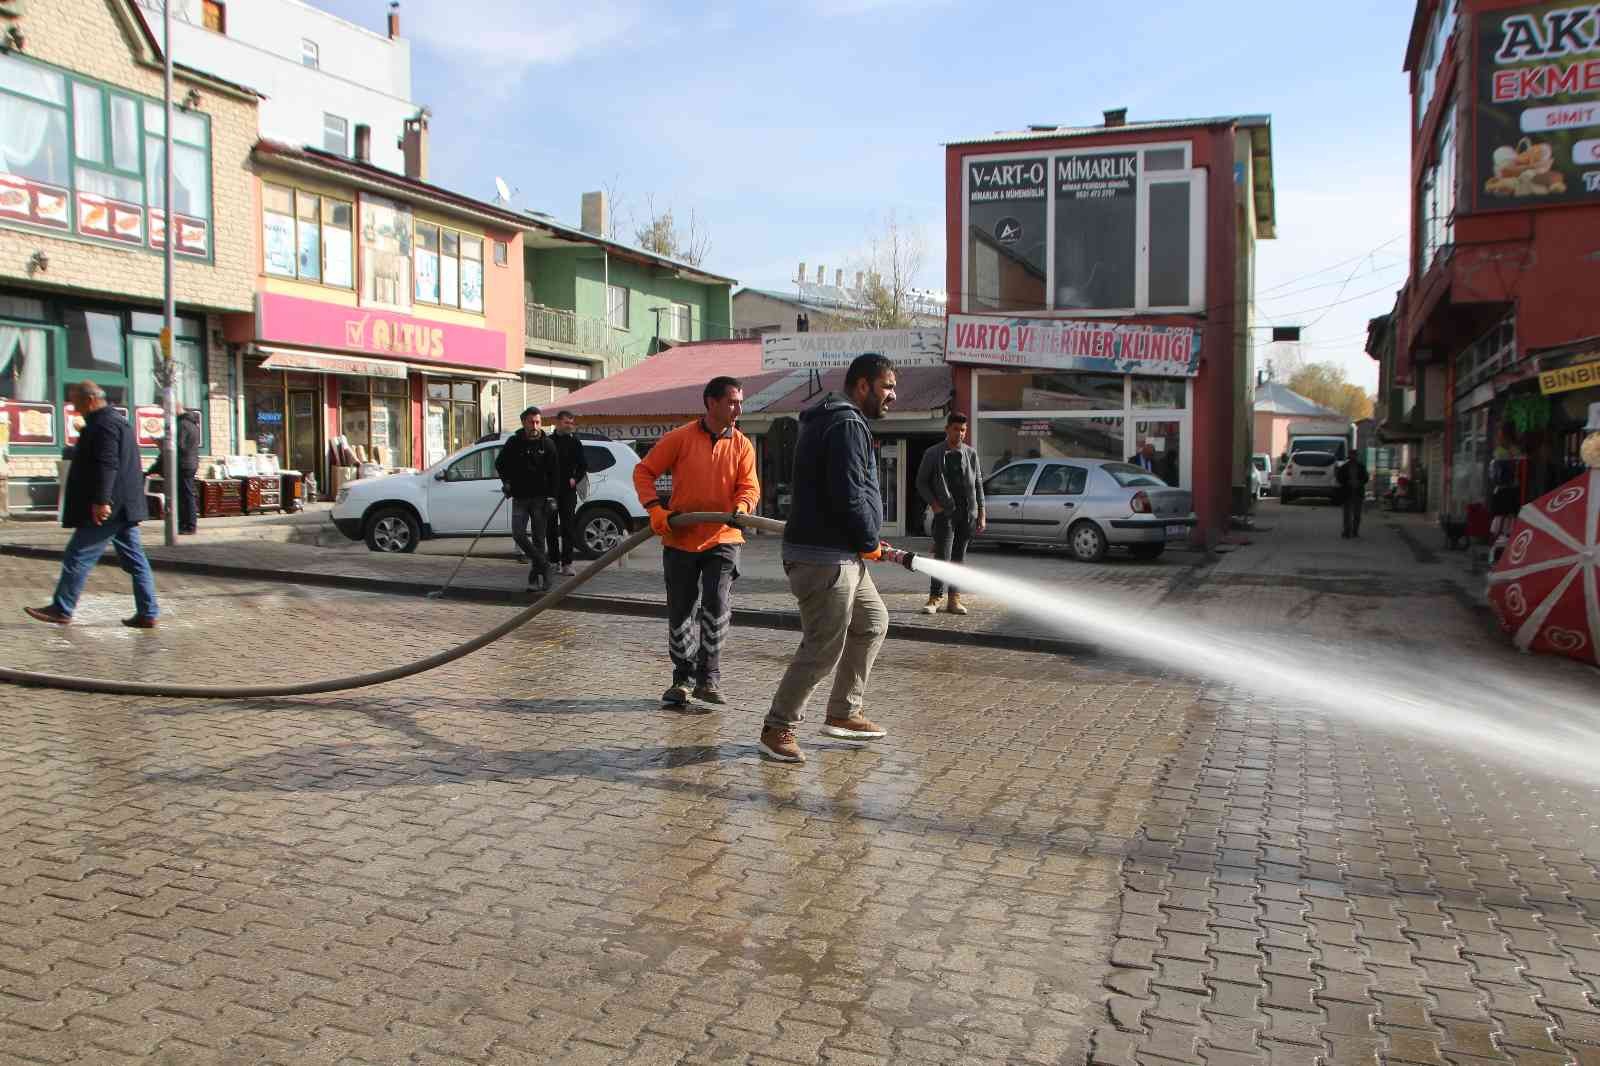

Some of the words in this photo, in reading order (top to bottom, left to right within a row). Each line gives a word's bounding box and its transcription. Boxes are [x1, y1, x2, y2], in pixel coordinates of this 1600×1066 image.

[1495, 3, 1600, 64] AK
[972, 163, 1044, 187] V-ART-O
[1058, 155, 1137, 181] MİMARLIK
[373, 319, 444, 358] ALTUS
[956, 323, 1011, 351] VARTO
[1542, 367, 1600, 390] BİNBİ
